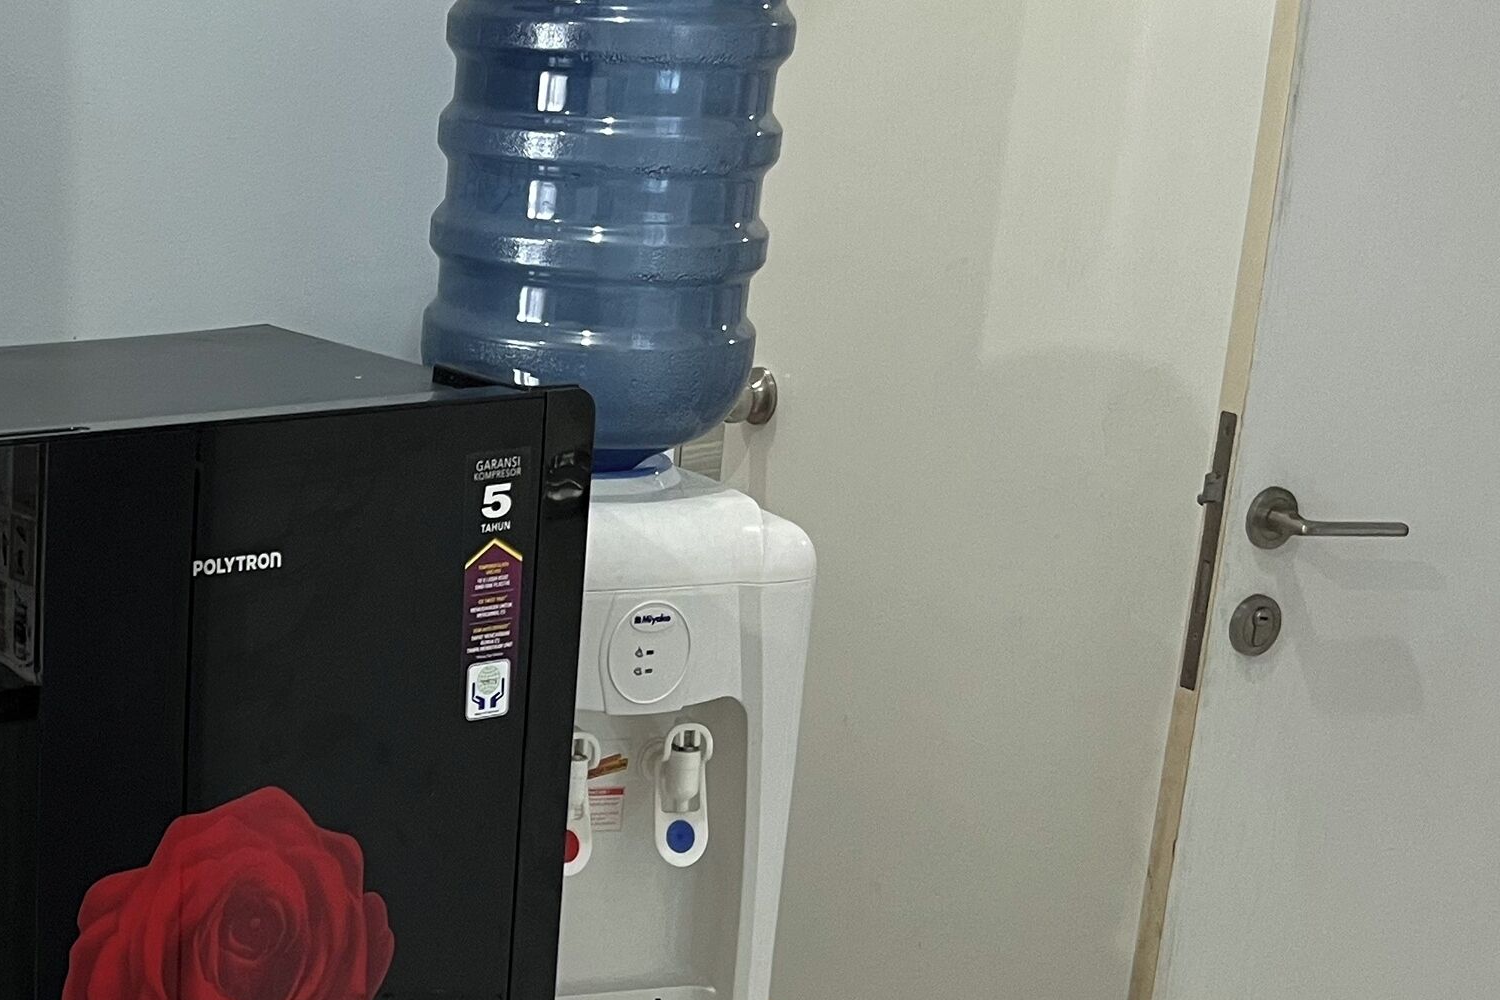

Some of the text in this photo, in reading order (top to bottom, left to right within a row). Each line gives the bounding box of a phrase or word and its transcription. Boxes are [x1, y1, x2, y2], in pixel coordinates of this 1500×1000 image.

[475, 456, 521, 472] GARANSI
[474, 467, 522, 481] KOMPRESOR
[481, 482, 512, 519] 5
[480, 521, 511, 533] TAHUN
